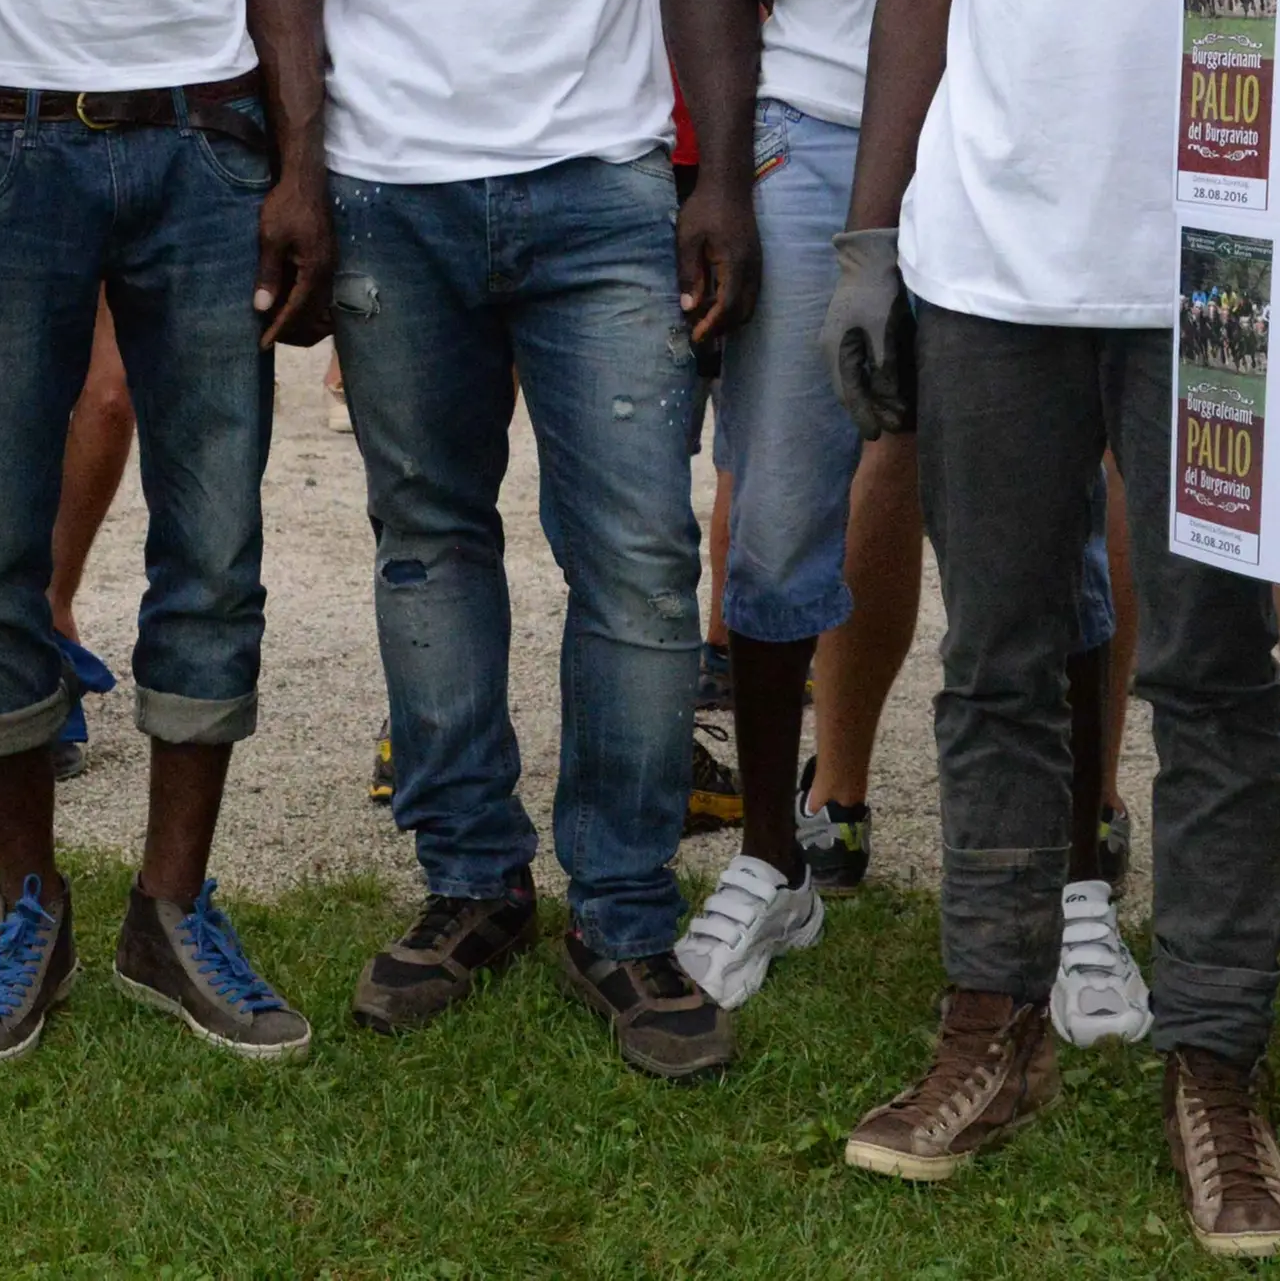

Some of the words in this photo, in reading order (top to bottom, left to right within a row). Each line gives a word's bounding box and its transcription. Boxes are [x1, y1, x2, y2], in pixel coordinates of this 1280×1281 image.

[1192, 46, 1262, 69] Burggrafenamt
[1191, 72, 1260, 123] PALIO
[1188, 122, 1201, 140] del
[1205, 123, 1259, 146] Burgraviato
[1193, 187, 1248, 203] 28.08.2016
[1187, 392, 1253, 425] Burggrafenamt
[1187, 416, 1251, 477] PALIO
[1185, 467, 1197, 485] del
[1200, 472, 1251, 500] Burgraviato
[1190, 531, 1241, 555] 28.08.2016
